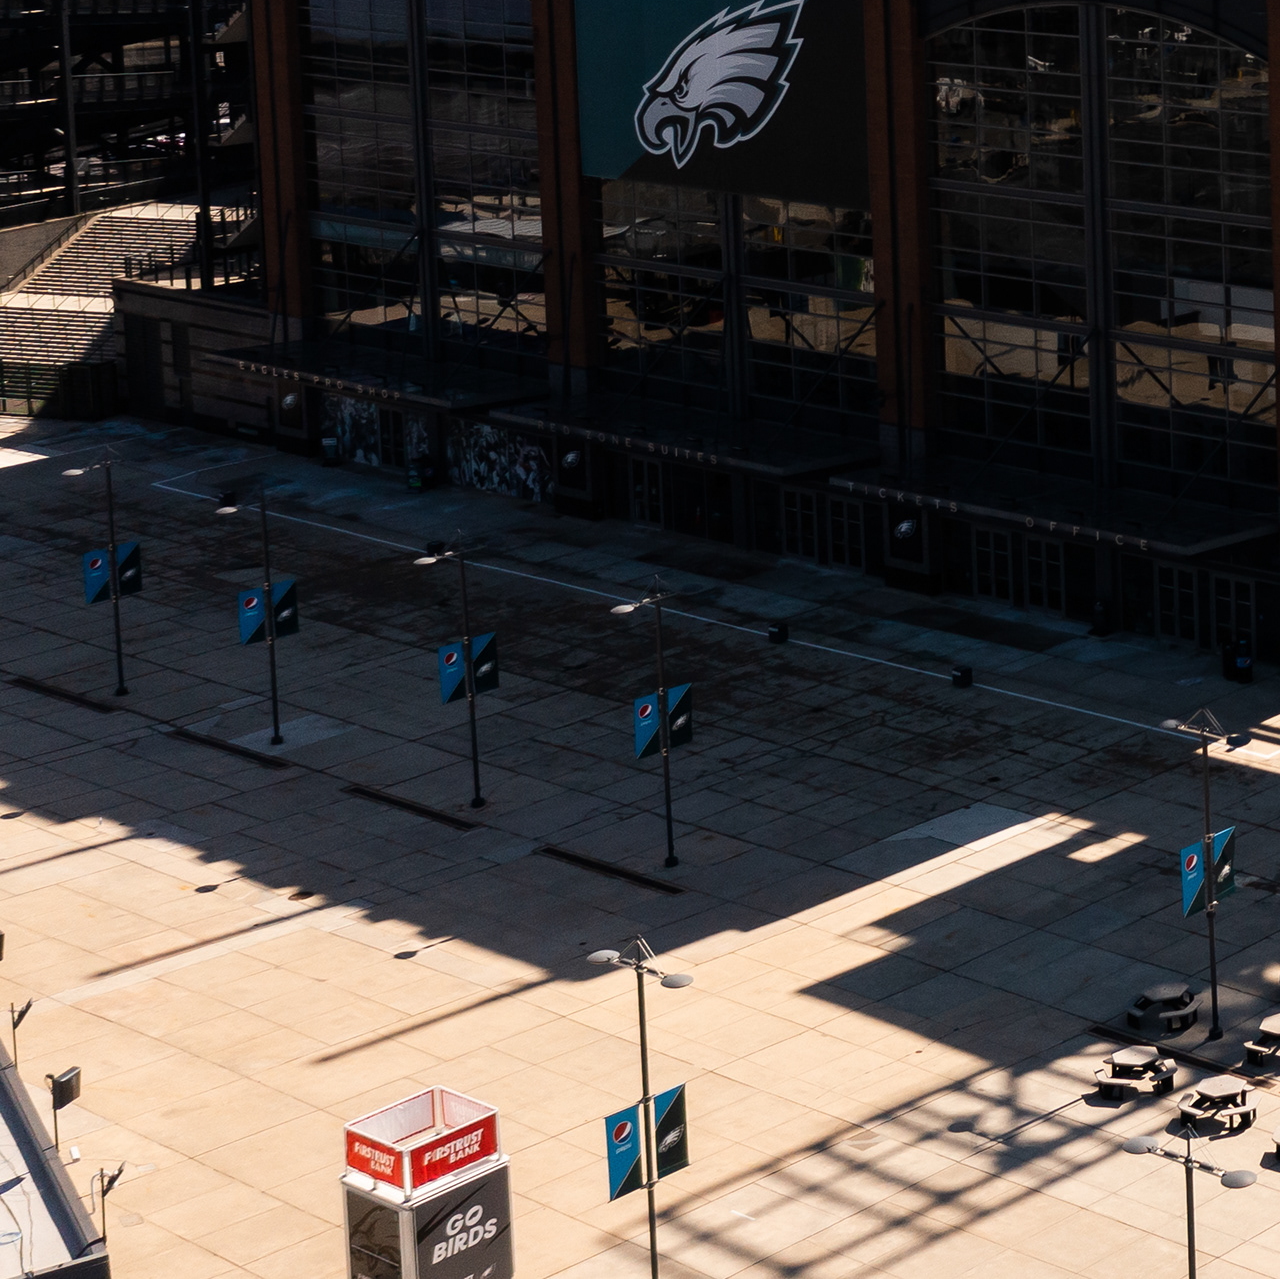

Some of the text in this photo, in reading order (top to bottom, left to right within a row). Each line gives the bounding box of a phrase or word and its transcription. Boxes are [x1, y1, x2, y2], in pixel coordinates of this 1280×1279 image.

[238, 361, 401, 401] EAGLES PRO SHOP
[537, 420, 718, 465] RED ZONE SUITES
[847, 481, 1148, 551] TICKETS OFFICE
[353, 1141, 396, 1167] FIRSTRUST
[424, 1128, 484, 1166] FIRSTRUST
[449, 1141, 481, 1164] BANK
[370, 1159, 394, 1176] BANK
[446, 1204, 484, 1236] GO
[432, 1217, 498, 1265] BIRDS
